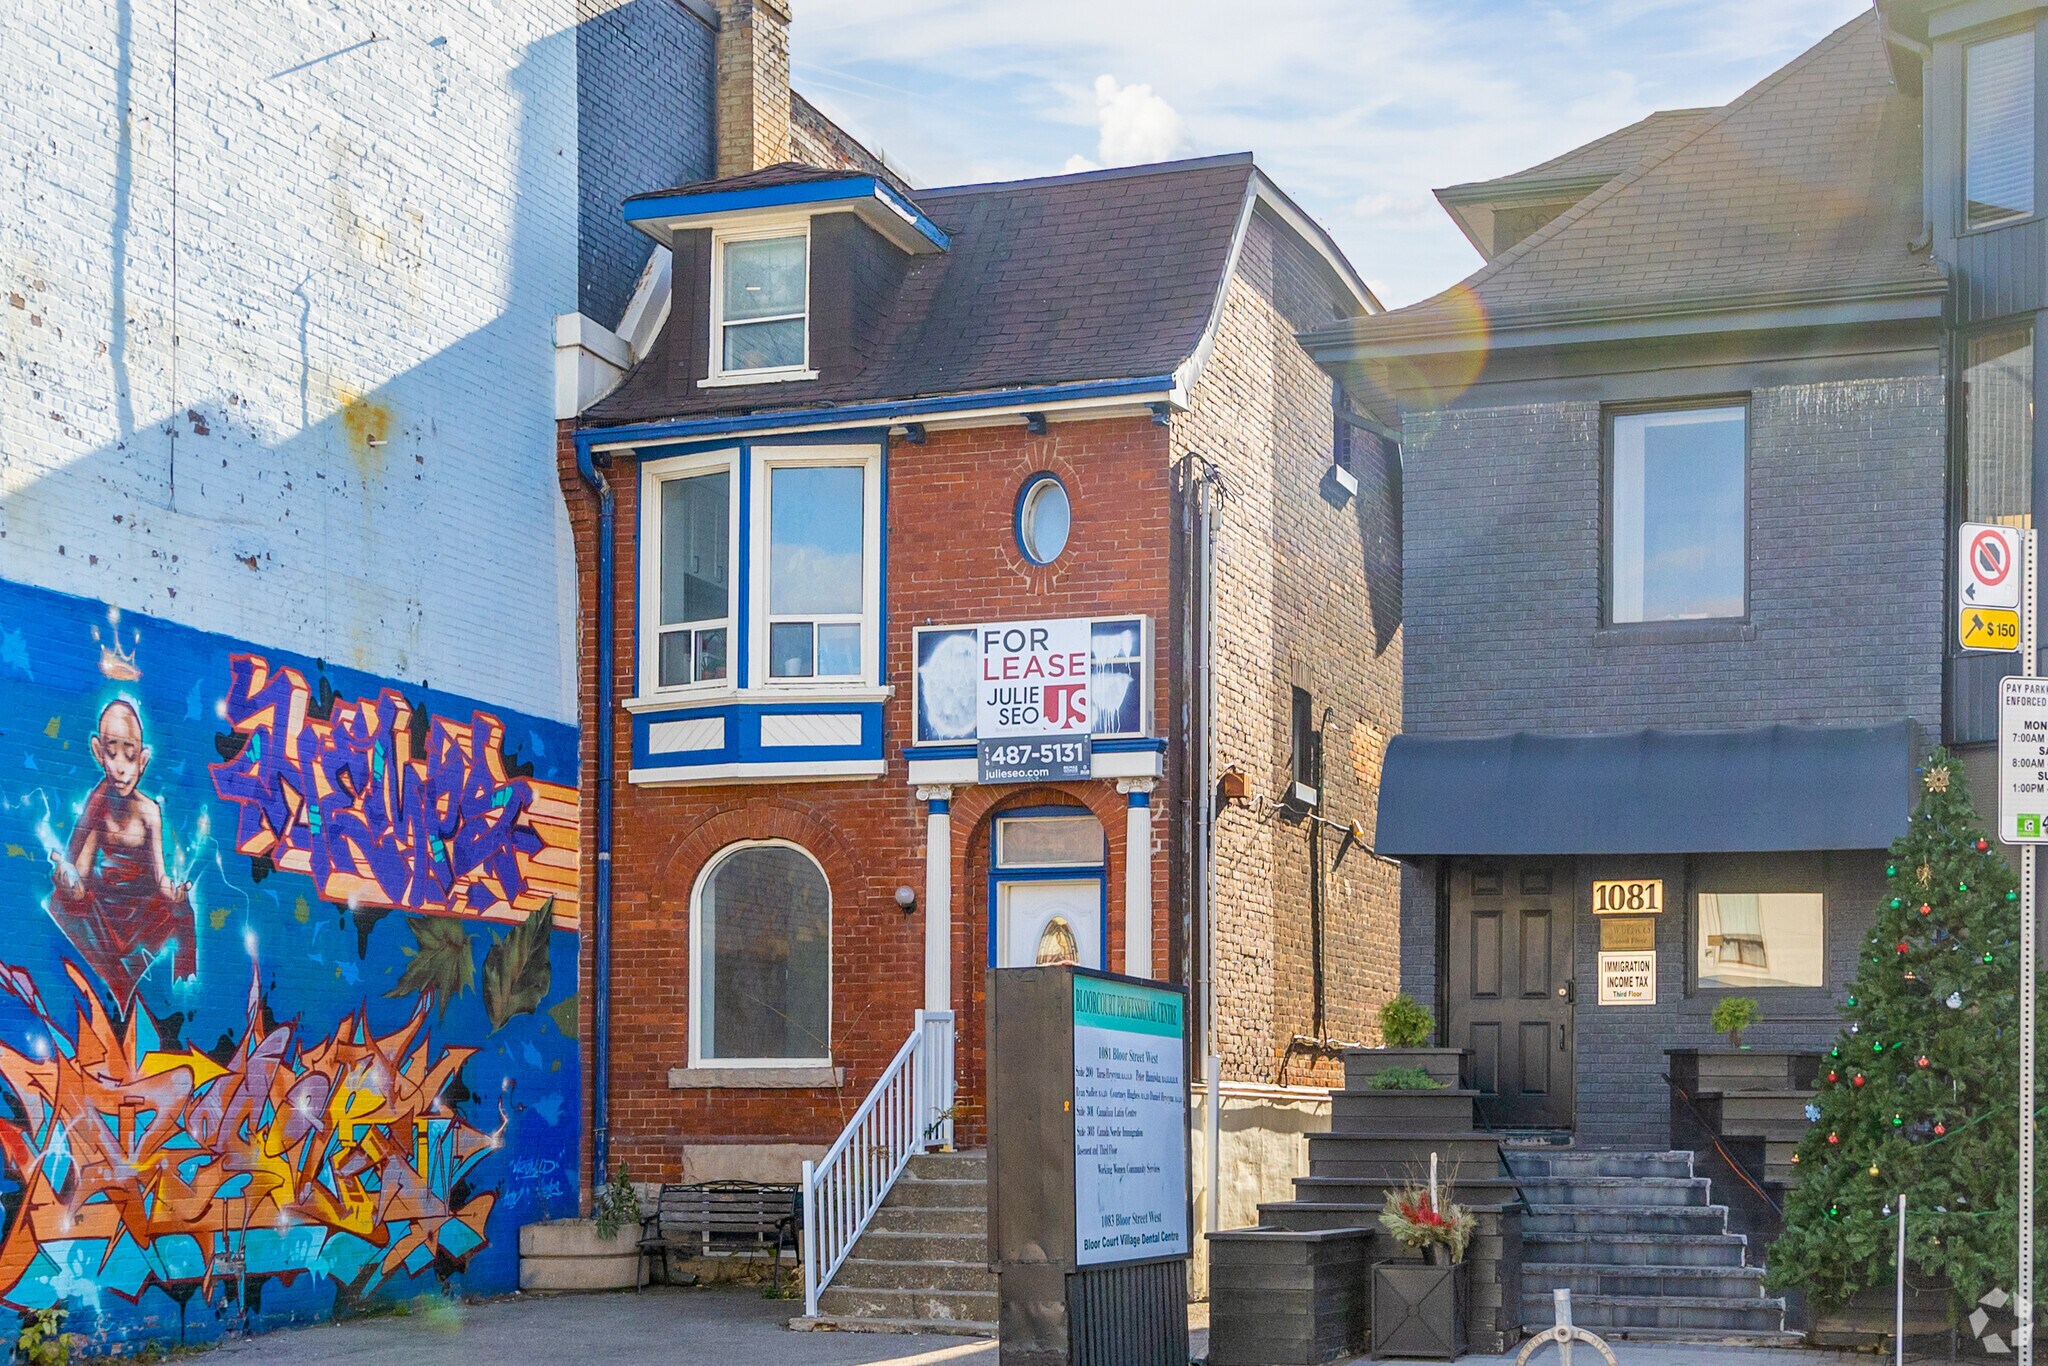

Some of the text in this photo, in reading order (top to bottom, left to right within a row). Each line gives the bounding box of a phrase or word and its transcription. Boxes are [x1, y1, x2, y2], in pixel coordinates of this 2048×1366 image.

[984, 628, 1049, 654] FOR
[983, 652, 1086, 681] LEASE
[2006, 684, 2022, 693] PAY
[987, 686, 1040, 706] JULIE
[2006, 696, 2047, 707] ENFORCED
[999, 706, 1039, 726] SEO
[2024, 721, 2048, 731] MON
[2012, 733, 2045, 743] 7:00AM
[991, 743, 1083, 765] 487-5131
[2012, 758, 2045, 768] 8:00AM
[985, 769, 1050, 781] julieseo.com
[2012, 783, 2044, 793] 1:00PM
[1596, 883, 1659, 911] 1081
[1604, 960, 1650, 973] IMMIGRATION
[1607, 976, 1649, 988] INCOME TAX
[1613, 990, 1628, 998] Third
[1075, 988, 1117, 1017] BLOORCOURT
[1157, 1003, 1178, 1026] CENTRE
[1098, 1046, 1159, 1065] 1081 Bloor Street West
[1115, 1213, 1132, 1226] Bloor
[1132, 1212, 1148, 1226] Street
[1148, 1211, 1162, 1224] West
[1083, 1230, 1179, 1251] Bloor Court Village Dental Centre
